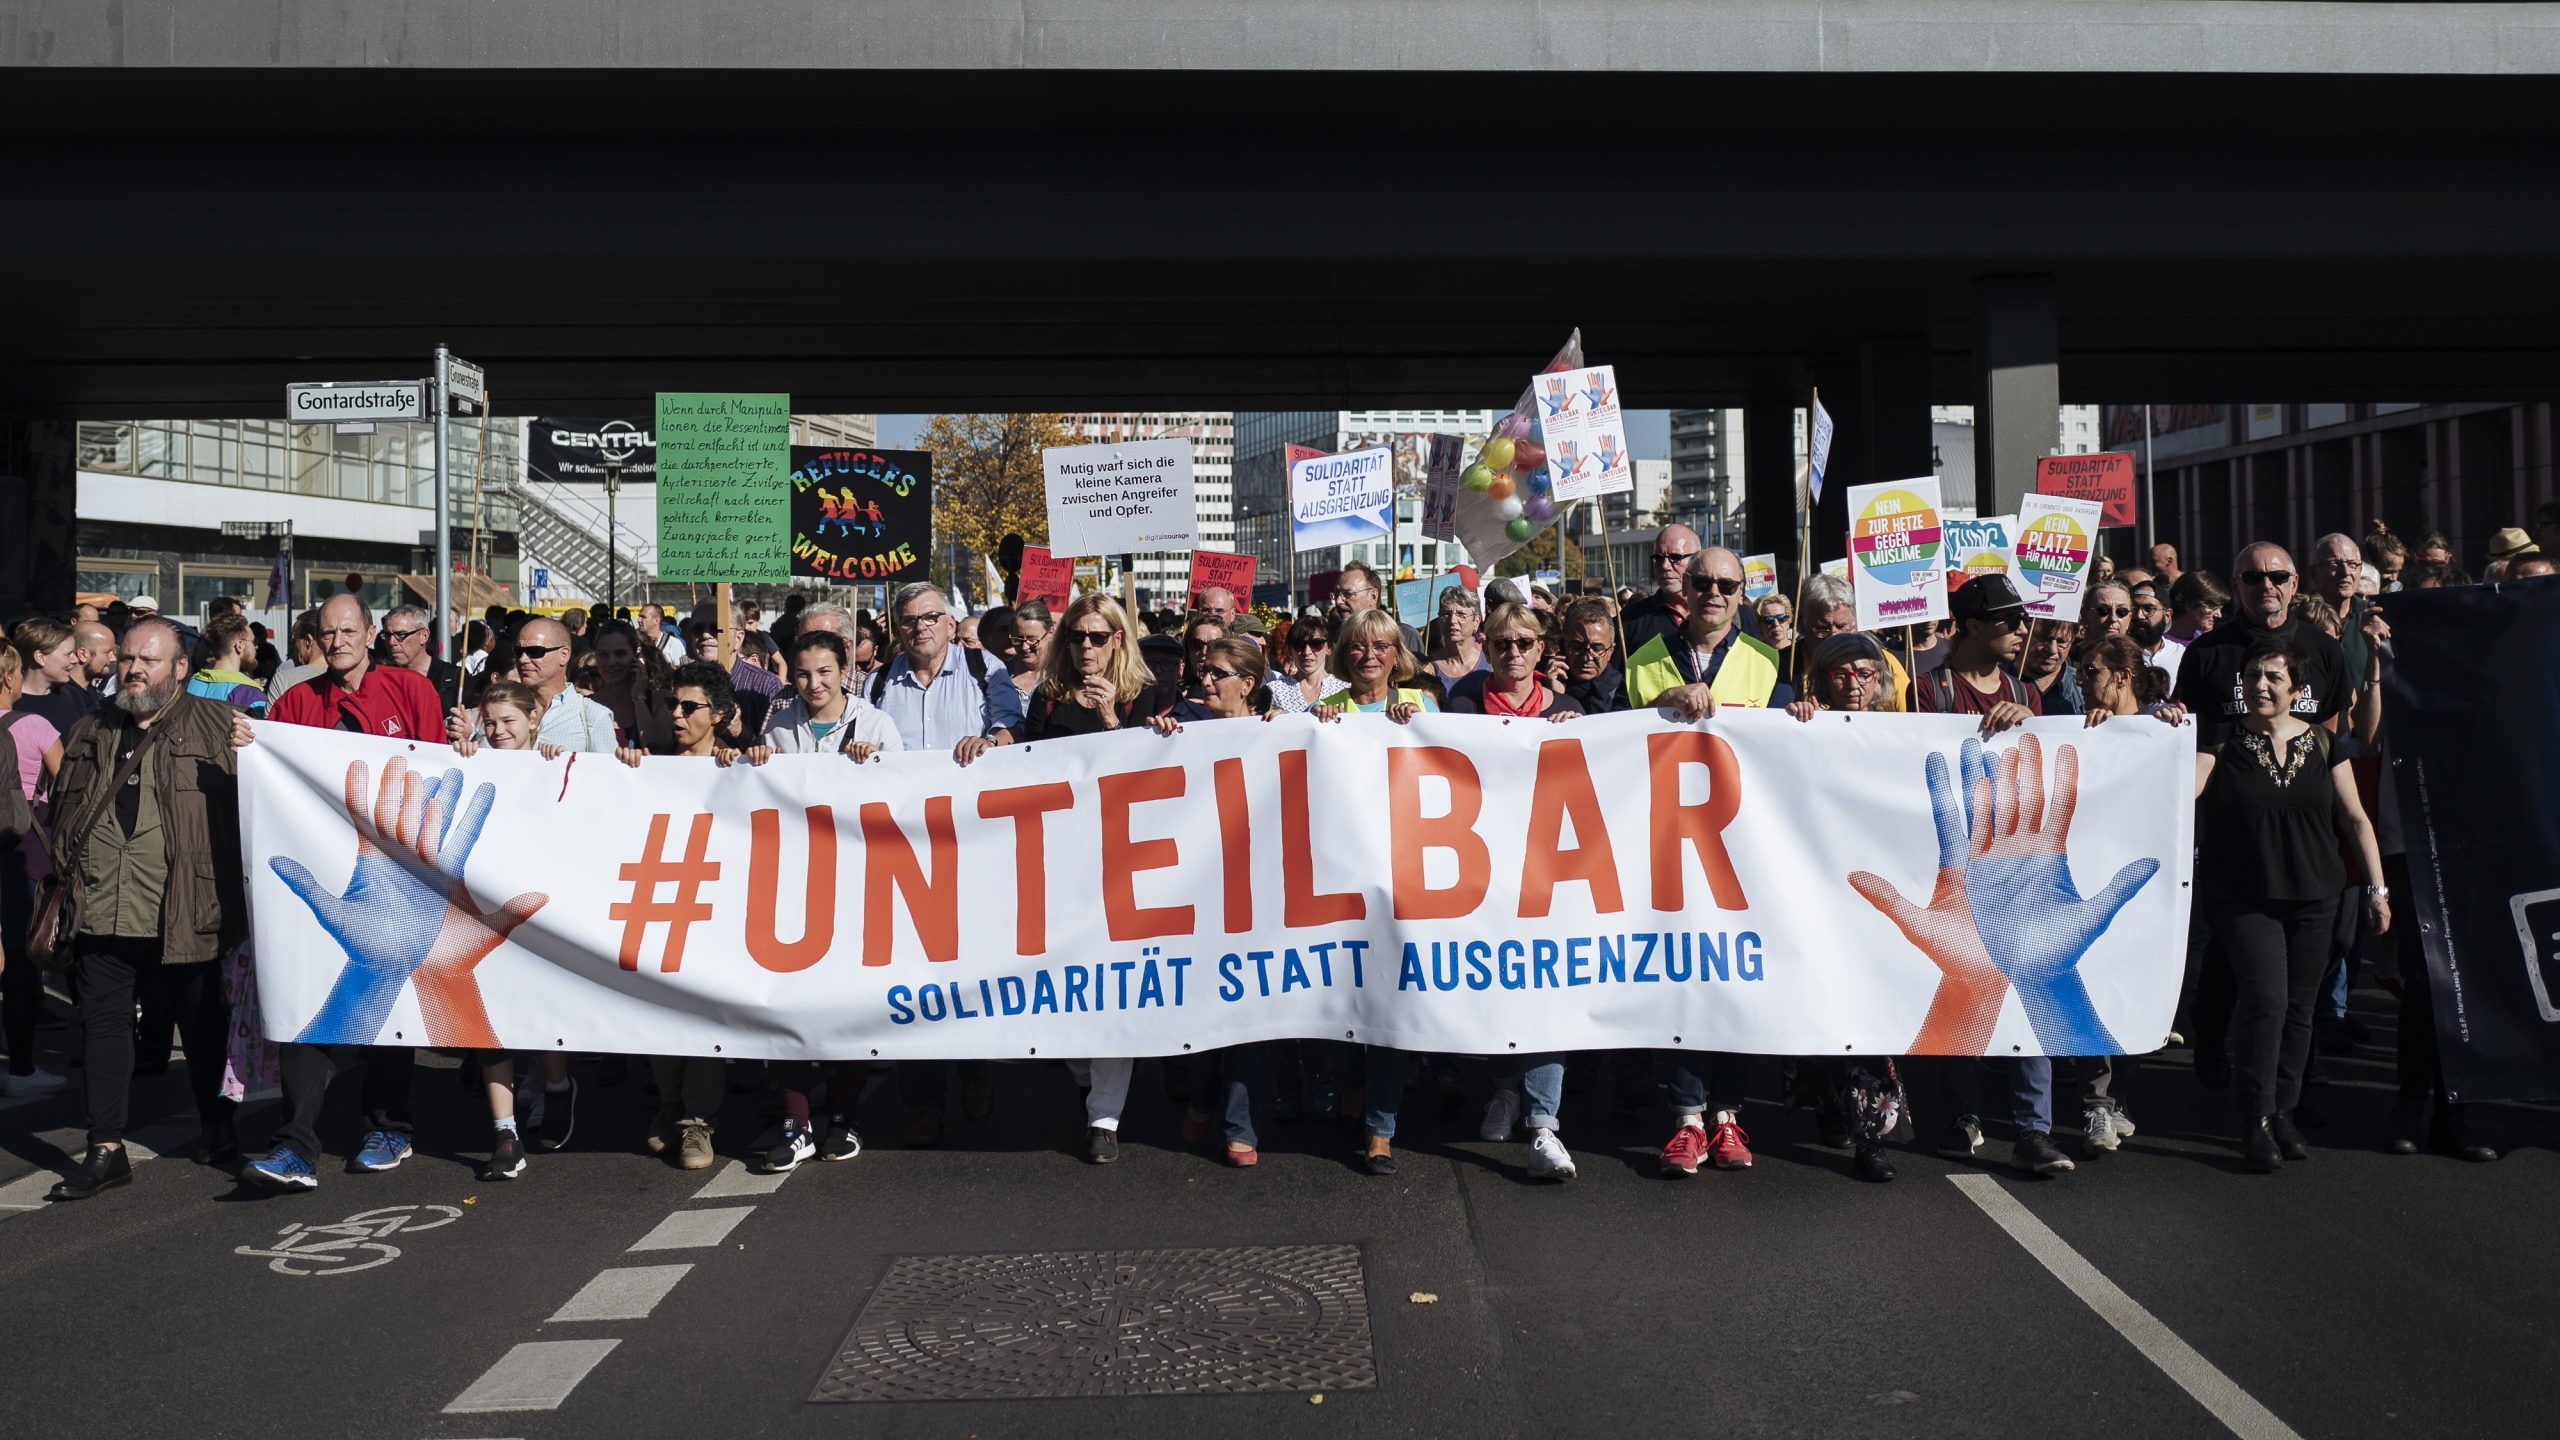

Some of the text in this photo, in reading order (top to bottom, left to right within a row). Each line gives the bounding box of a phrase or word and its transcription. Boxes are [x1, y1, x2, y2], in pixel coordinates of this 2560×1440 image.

[297, 389, 415, 411] Gontardstraße
[661, 398, 788, 419] Wenn durch Manipula-
[661, 417, 790, 433] tionen die Ressentiment
[661, 437, 786, 453] moral entfacht ist und
[559, 462, 574, 472] Wir
[661, 459, 678, 470] die
[1060, 456, 1175, 475] Mutig warf sich die
[1305, 452, 1385, 482] SOLIDARITÄT
[2047, 457, 2122, 475] SOLIDARITÄT
[662, 471, 790, 490] hysterisierte Zivilge-
[790, 452, 916, 497] REFUGEES
[1075, 474, 1162, 489] kleine Kamera
[2066, 474, 2103, 488] STATT
[1328, 476, 1366, 496] STATT
[663, 492, 785, 507] sellschaft nach einer
[1062, 487, 1178, 505] zwischen Angreifer
[1300, 488, 1390, 519] AUSGRENZUNG
[1089, 503, 1153, 518] und Opfer.
[1875, 498, 1901, 516] NEIN
[663, 510, 773, 525] politisch korrekten
[1868, 514, 1924, 535] ZUR HETZE
[2044, 516, 2070, 534] KEIN
[663, 526, 739, 543] Zwangsjacke
[1144, 533, 1190, 541] digitalcourage
[1874, 531, 1910, 550] GEGEN
[2027, 531, 2073, 555] PLATZ
[661, 548, 691, 558] dann
[695, 547, 739, 558] wächst
[744, 548, 771, 559] nach
[792, 532, 917, 578] WELCOME
[1869, 545, 1921, 566] MUSLIME
[2026, 549, 2073, 572] FÜR NAZIS
[662, 561, 790, 578] druss die Abwehr zur Revolte
[1039, 568, 1058, 578] STATT
[1208, 569, 1233, 581] STATT
[609, 731, 1748, 972] #UNTEILBAR
[887, 931, 1763, 1024] SOLIDARITÄT STATT AUSGRENZUNG
